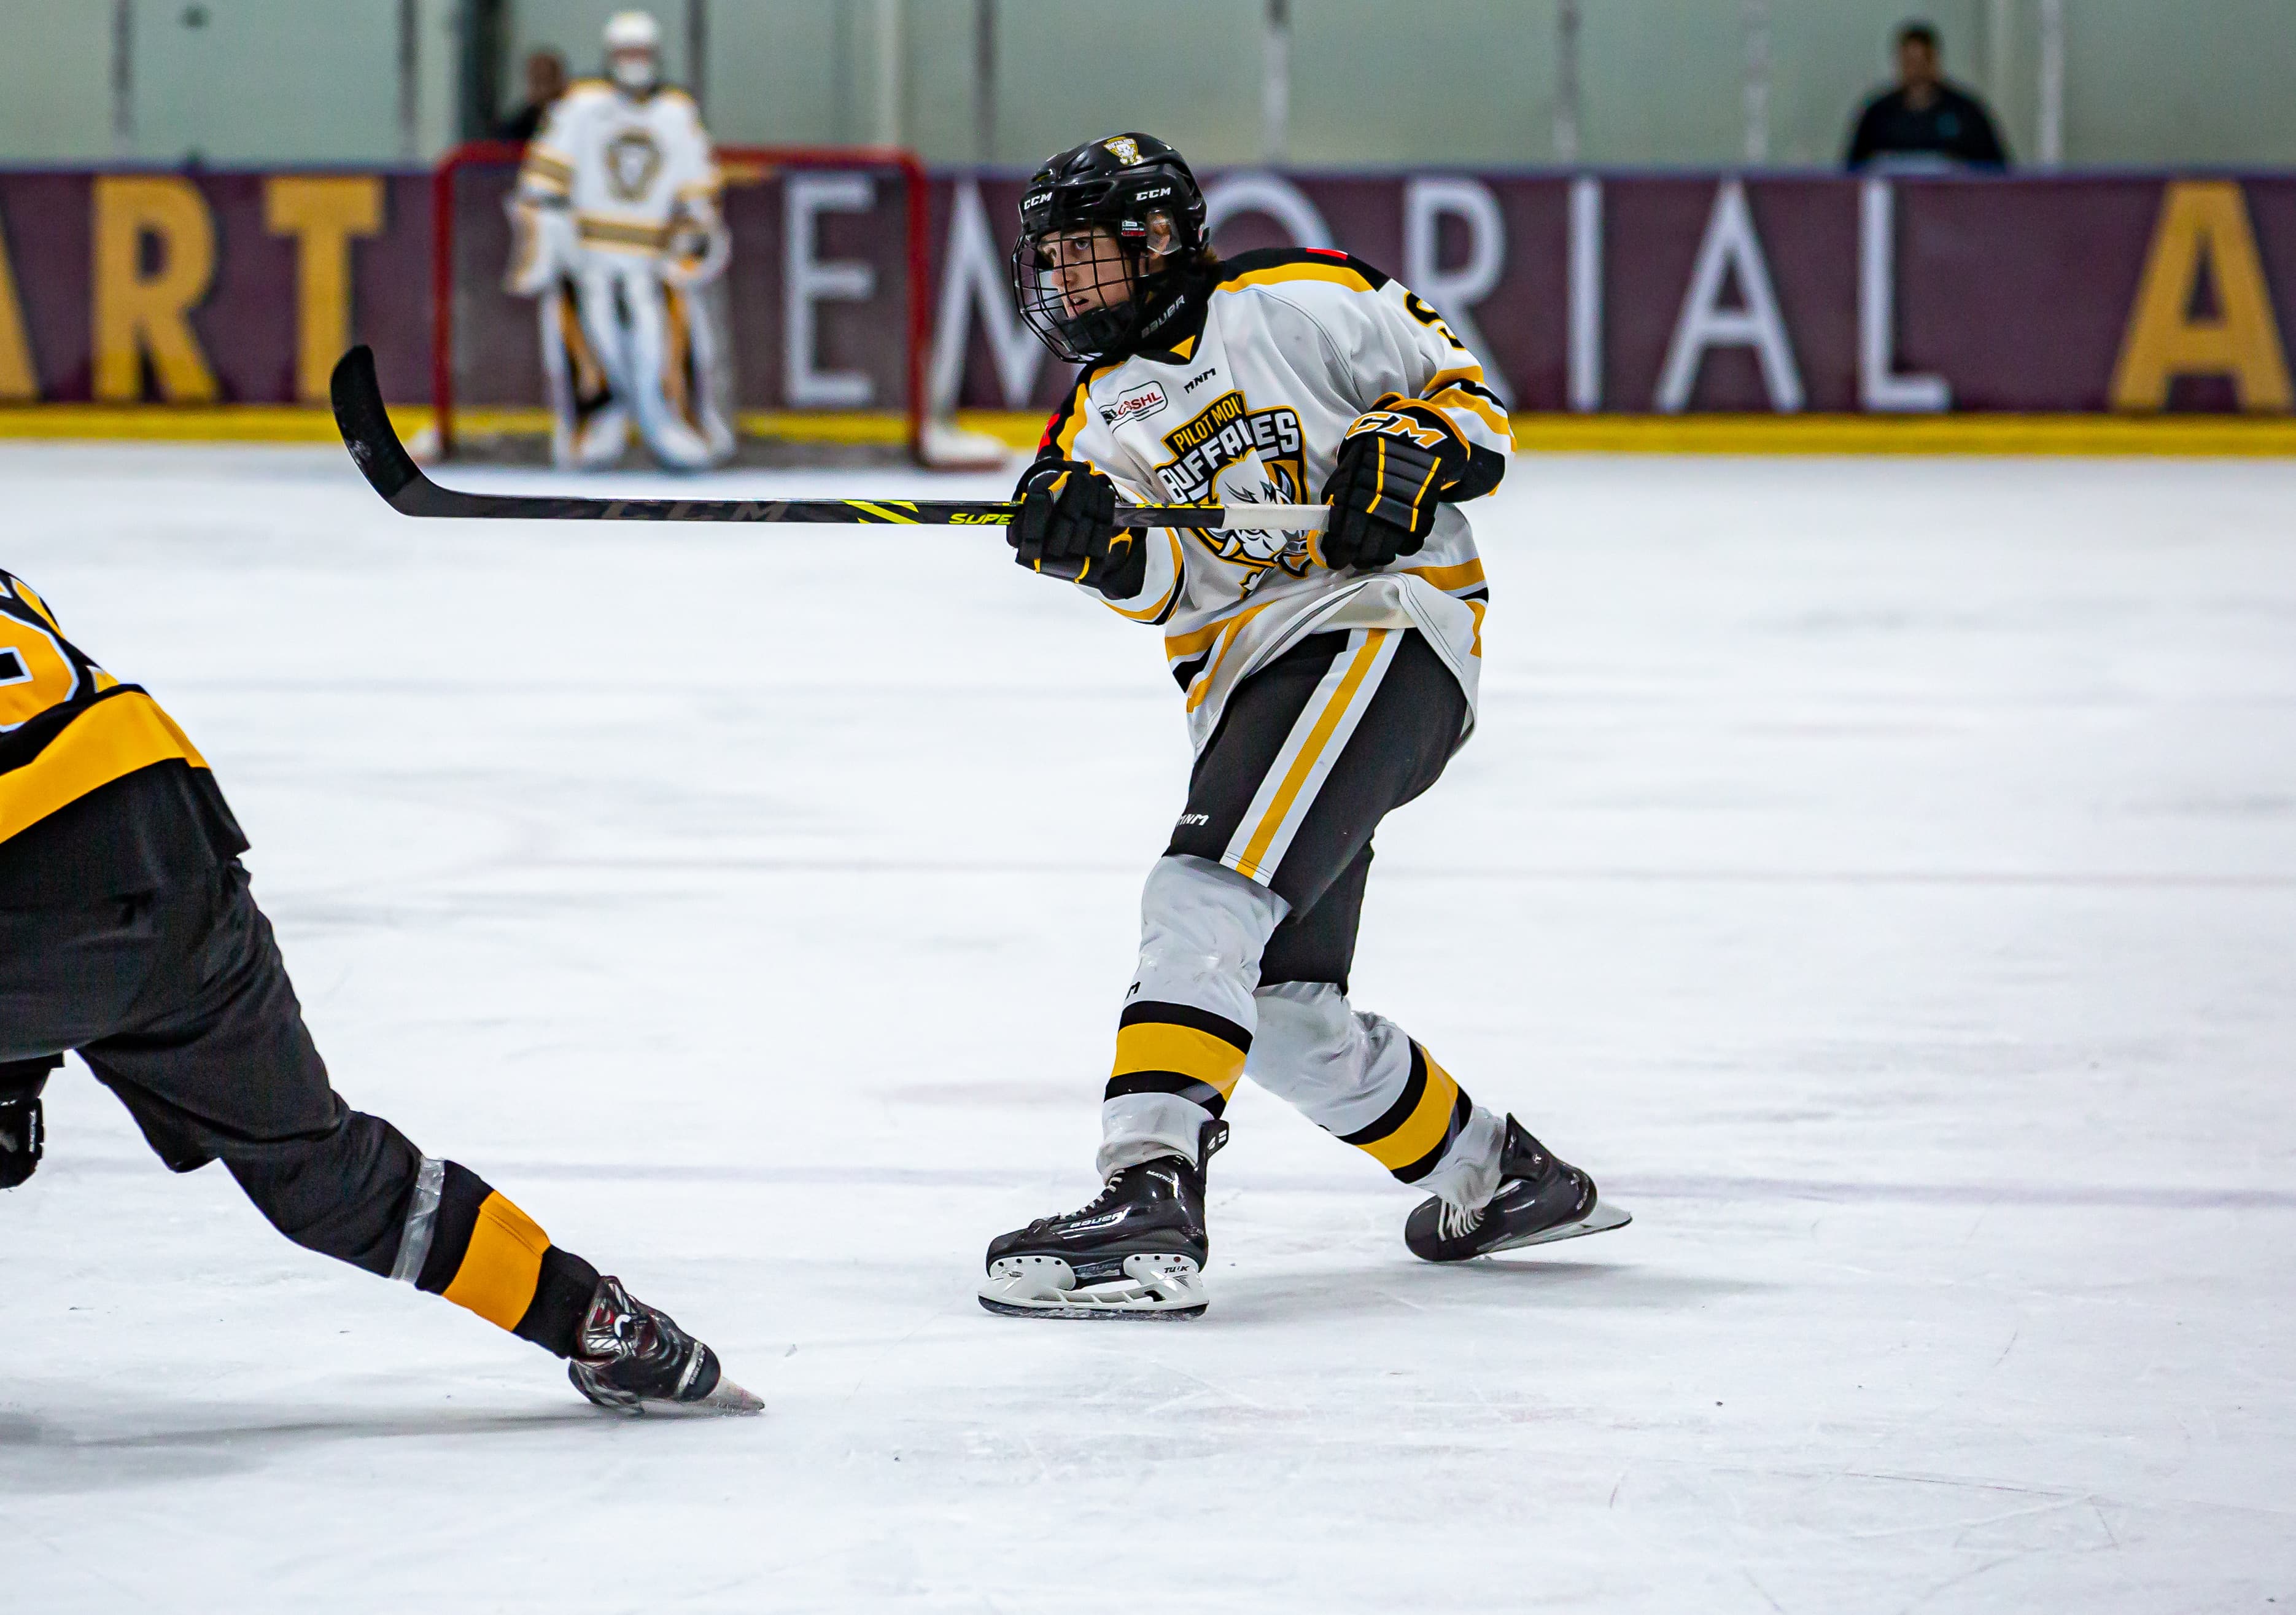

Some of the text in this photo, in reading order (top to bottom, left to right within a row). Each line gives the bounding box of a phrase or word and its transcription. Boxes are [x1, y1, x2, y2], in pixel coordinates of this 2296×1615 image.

[1024, 192, 1053, 210] CCM
[1136, 187, 1171, 201] CCM
[0, 176, 385, 403] RT
[1141, 295, 1185, 338] BAUER
[1184, 368, 1217, 394] MNM
[1173, 415, 1214, 453] PILOT
[1070, 1211, 1123, 1229] BAUER
